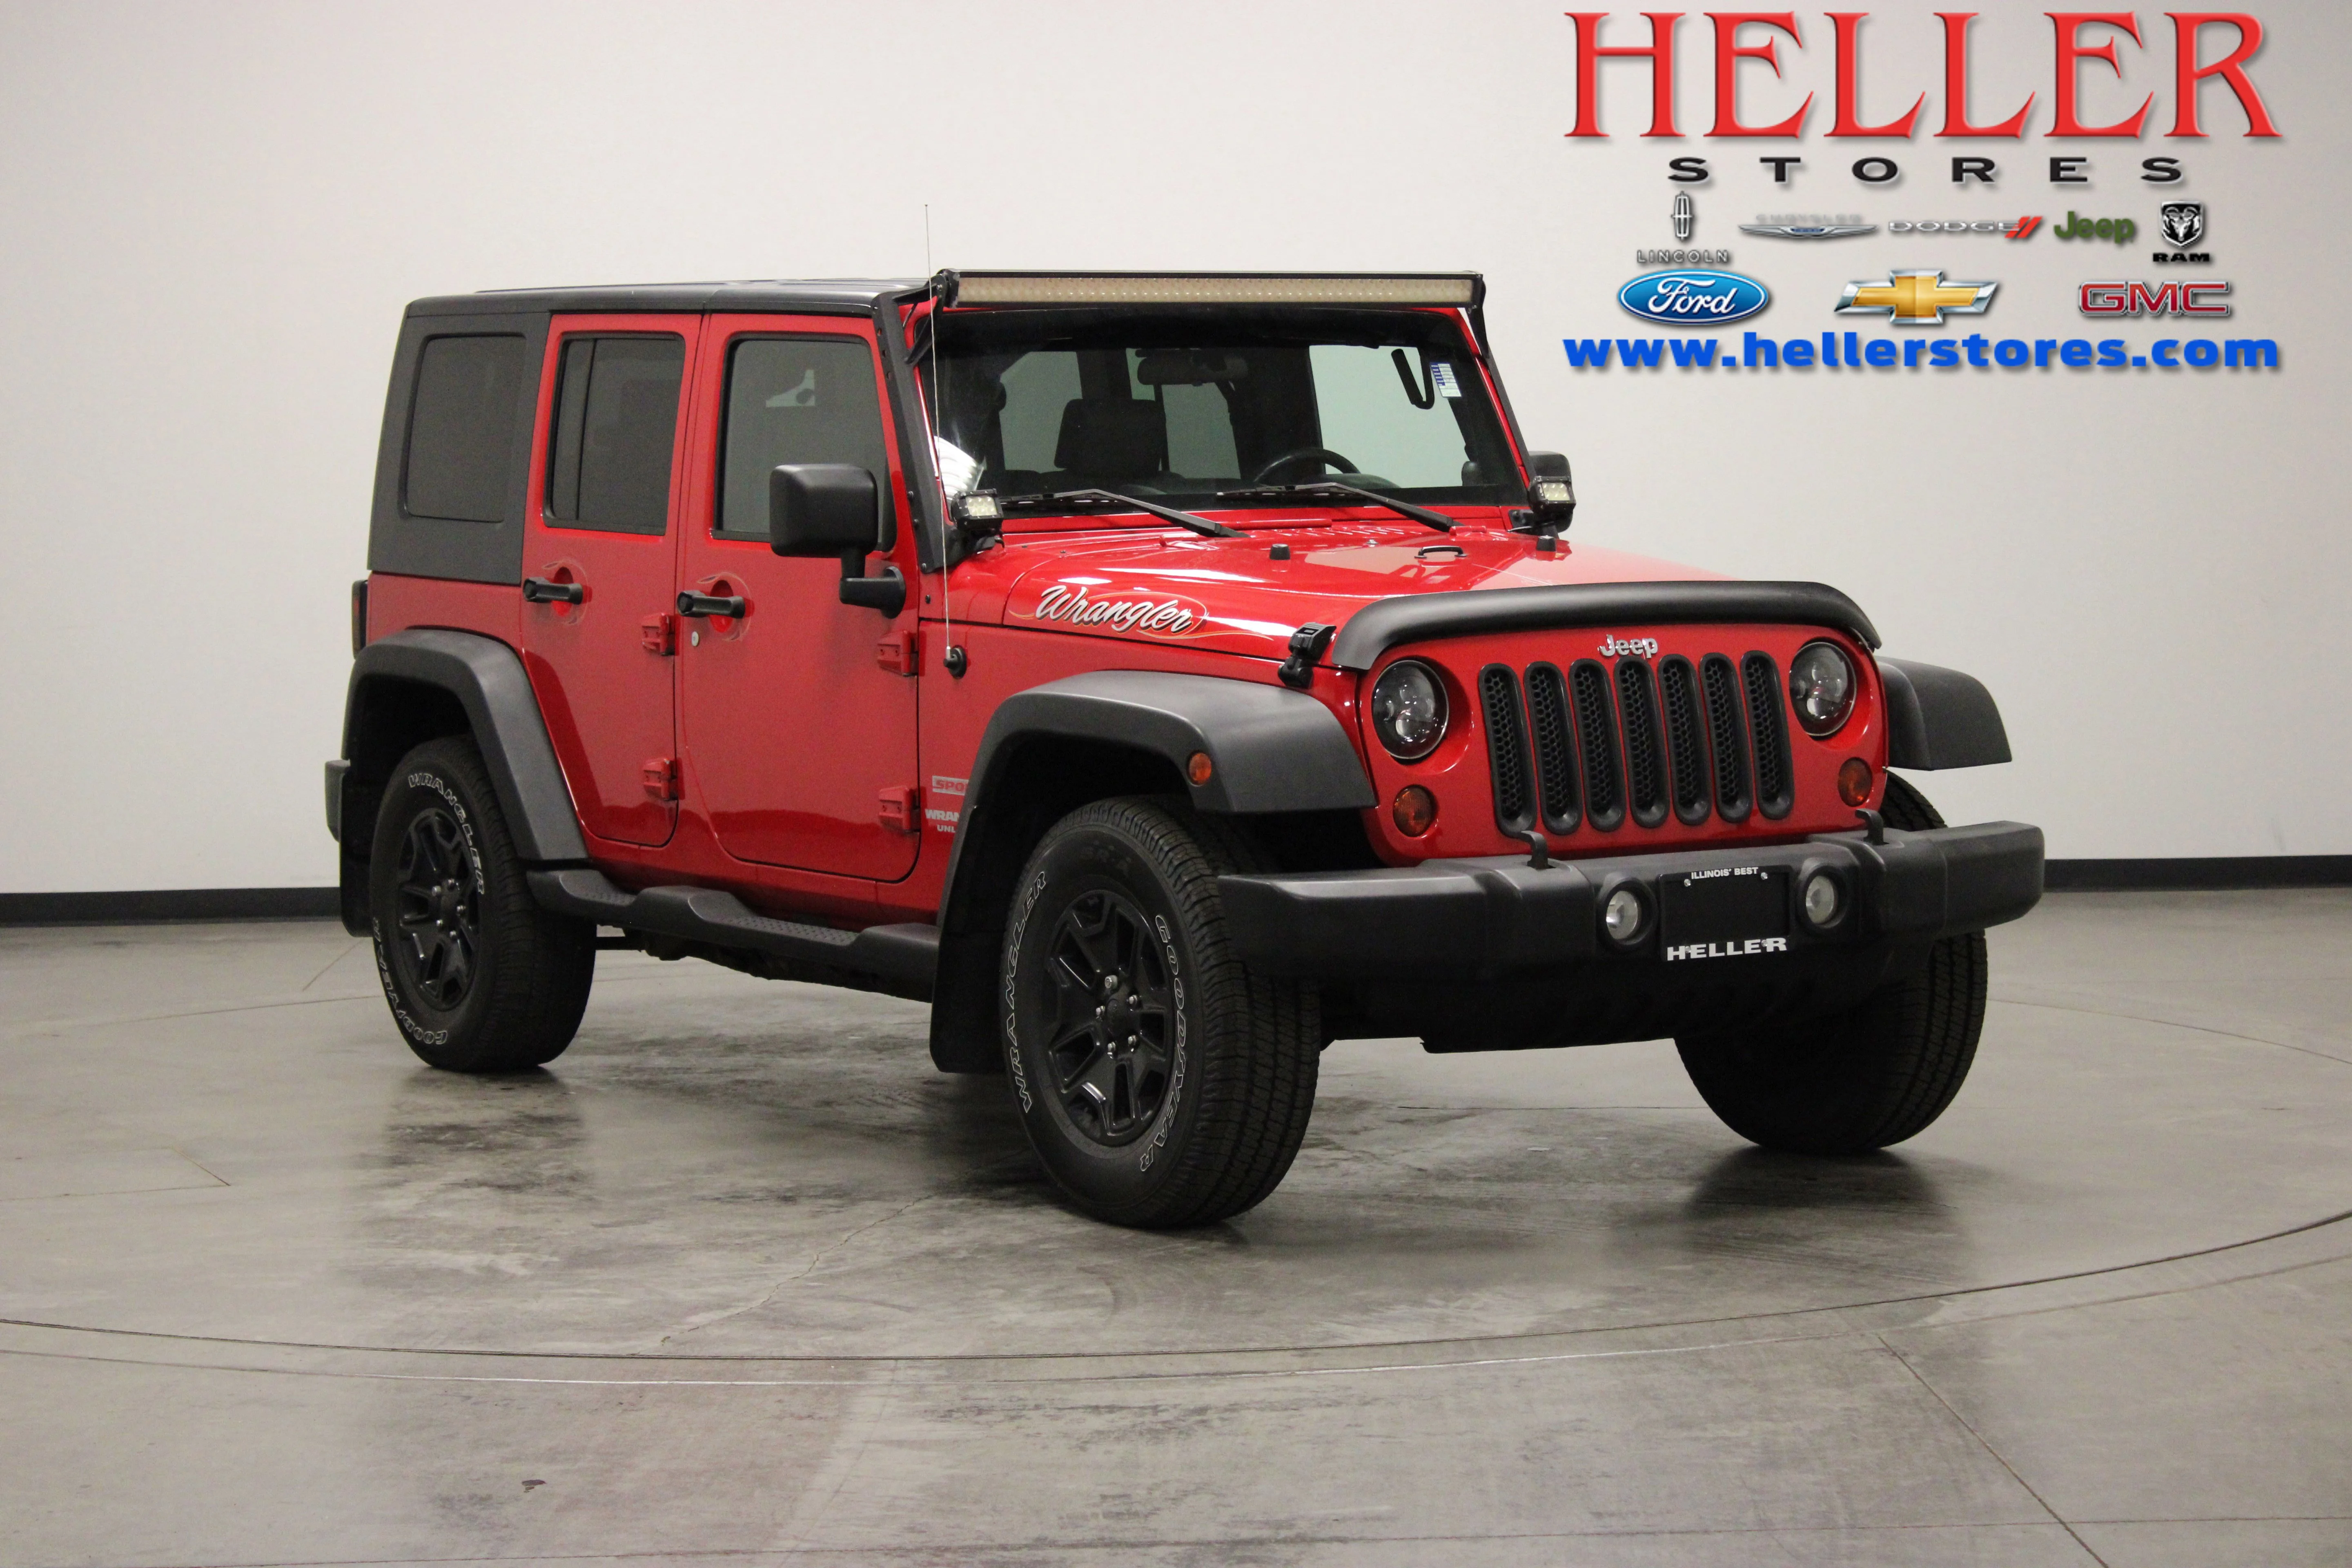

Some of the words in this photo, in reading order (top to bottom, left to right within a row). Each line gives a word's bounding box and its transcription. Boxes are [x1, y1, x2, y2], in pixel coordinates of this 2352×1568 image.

[1036, 585, 1193, 633] Wrangler
[1598, 634, 1658, 659] Jeep
[935, 780, 967, 791] SPO
[408, 773, 485, 895] WRANGLER
[1734, 866, 1759, 875] BEST
[1667, 938, 1787, 961] HELLER
[1005, 871, 1046, 1113] WRANGLER
[1140, 915, 1186, 1172] GOODYEAR
